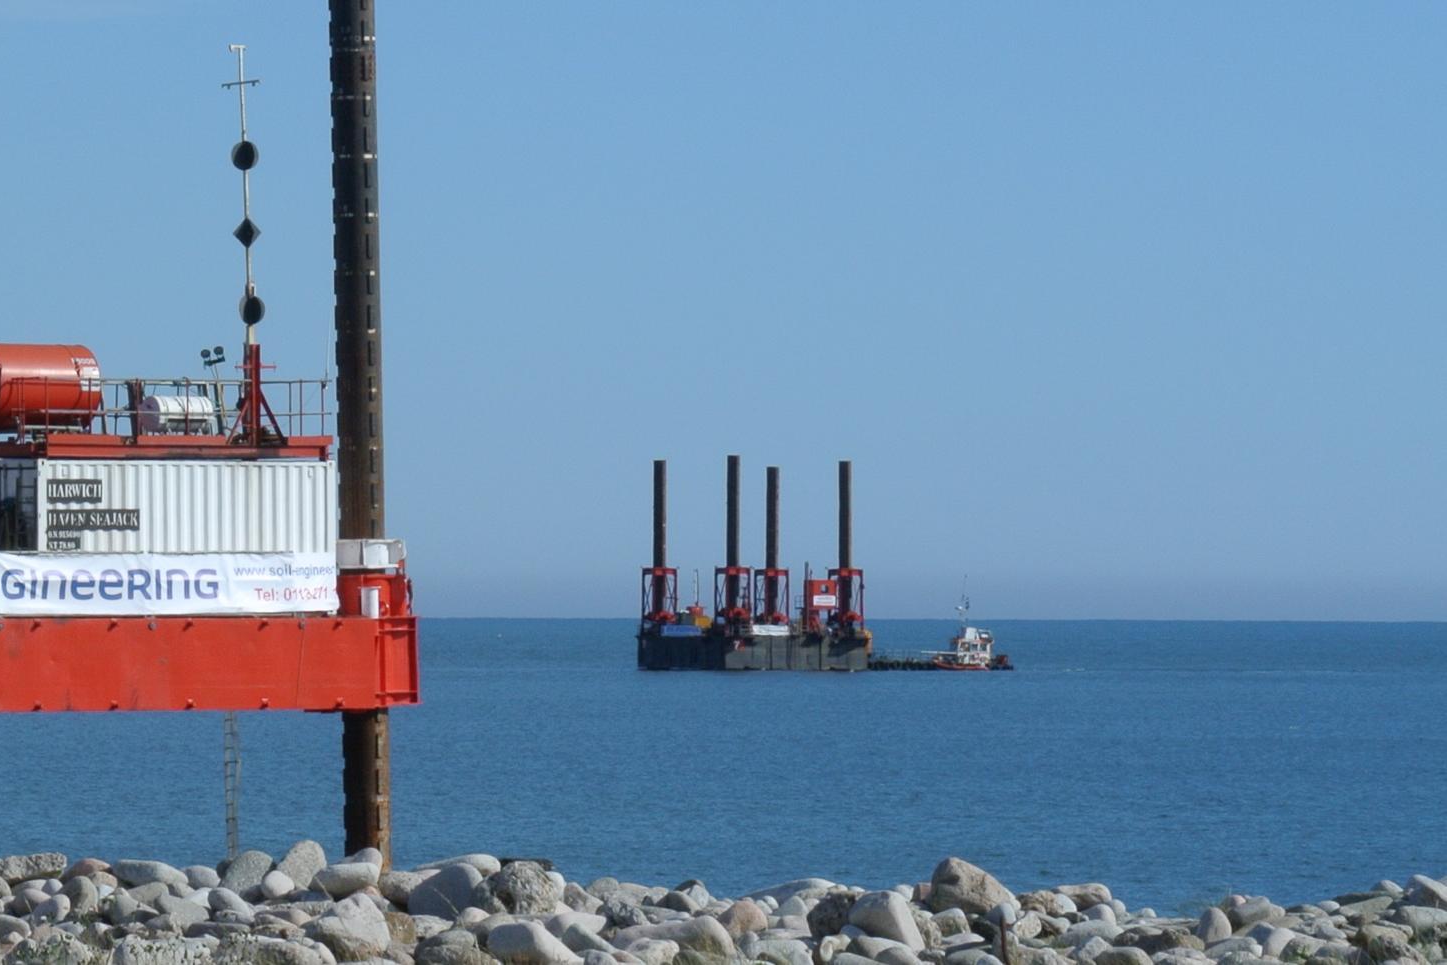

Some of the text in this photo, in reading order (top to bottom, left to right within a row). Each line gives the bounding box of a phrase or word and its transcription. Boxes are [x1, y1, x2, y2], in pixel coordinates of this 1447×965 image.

[48, 484, 101, 498] HARWICH
[48, 512, 138, 526] HAVEN SEAJACK
[254, 588, 279, 601] Tel:
